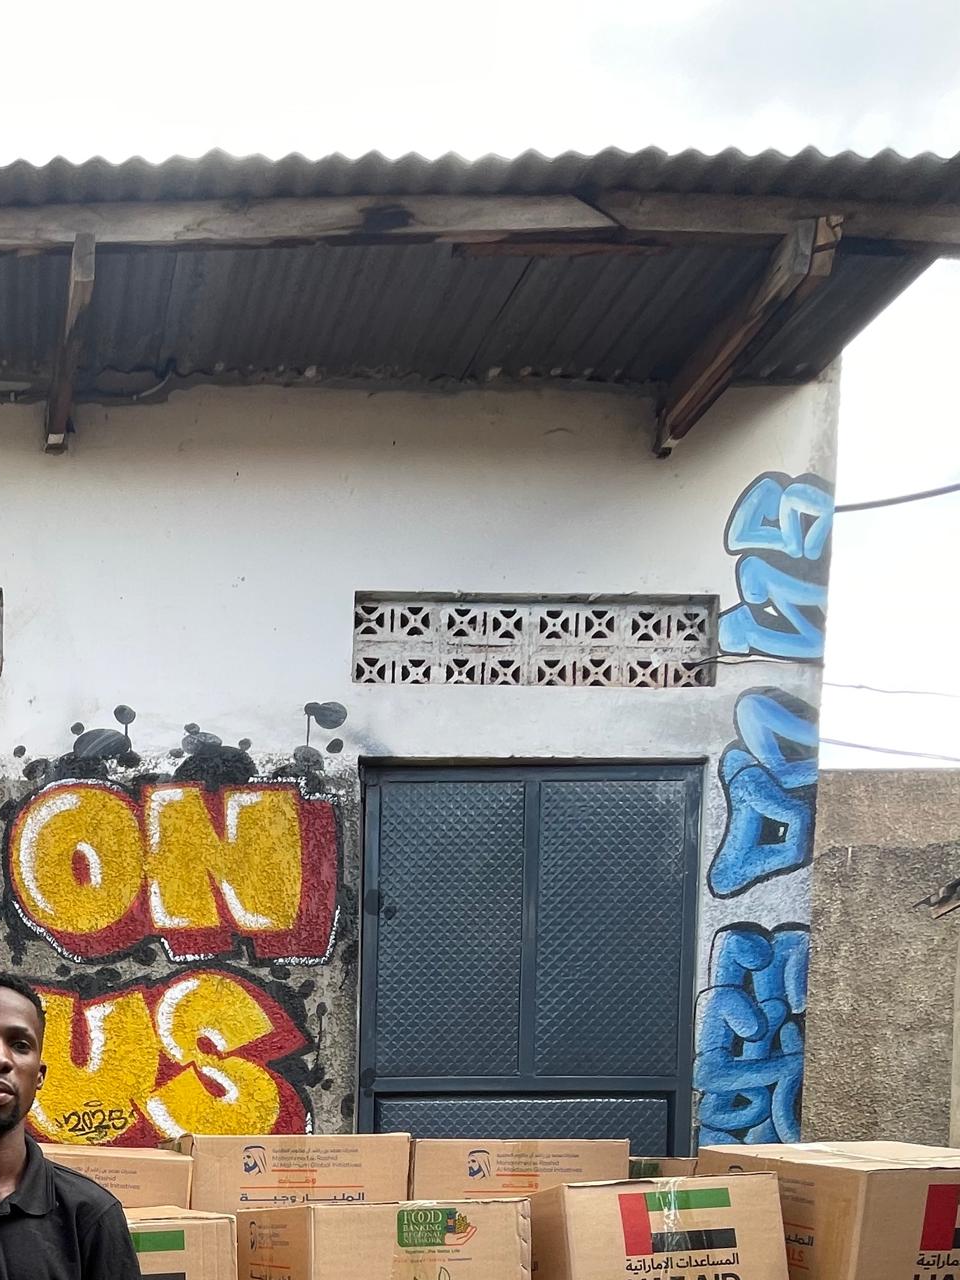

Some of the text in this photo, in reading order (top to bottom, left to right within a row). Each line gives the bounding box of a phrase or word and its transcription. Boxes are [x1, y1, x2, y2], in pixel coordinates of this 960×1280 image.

[10, 781, 318, 942] ON
[32, 968, 298, 1147] US
[403, 1209, 443, 1225] FOOD
